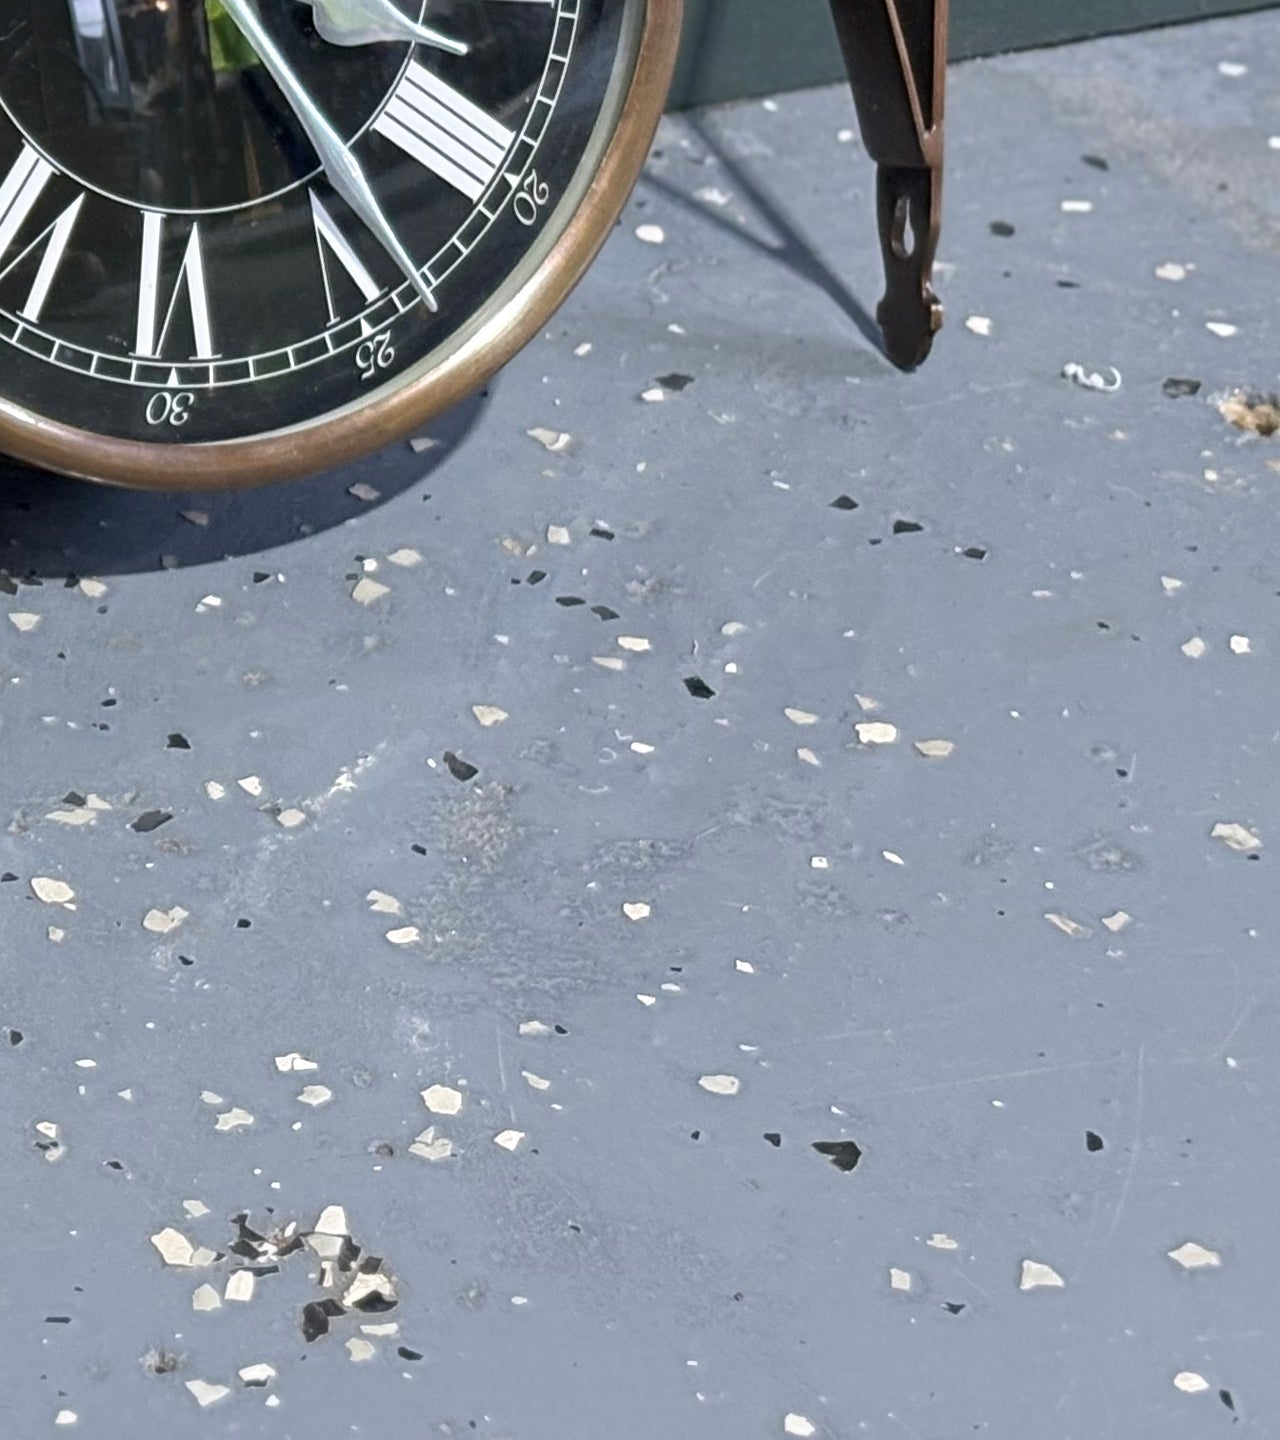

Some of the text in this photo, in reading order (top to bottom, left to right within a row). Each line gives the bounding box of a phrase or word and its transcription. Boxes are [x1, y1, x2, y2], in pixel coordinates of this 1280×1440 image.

[368, 55, 518, 206] IIII
[512, 167, 551, 227] 20
[128, 210, 223, 361] VI
[307, 186, 390, 328] V
[354, 329, 396, 381] 25
[144, 391, 196, 427] 30
